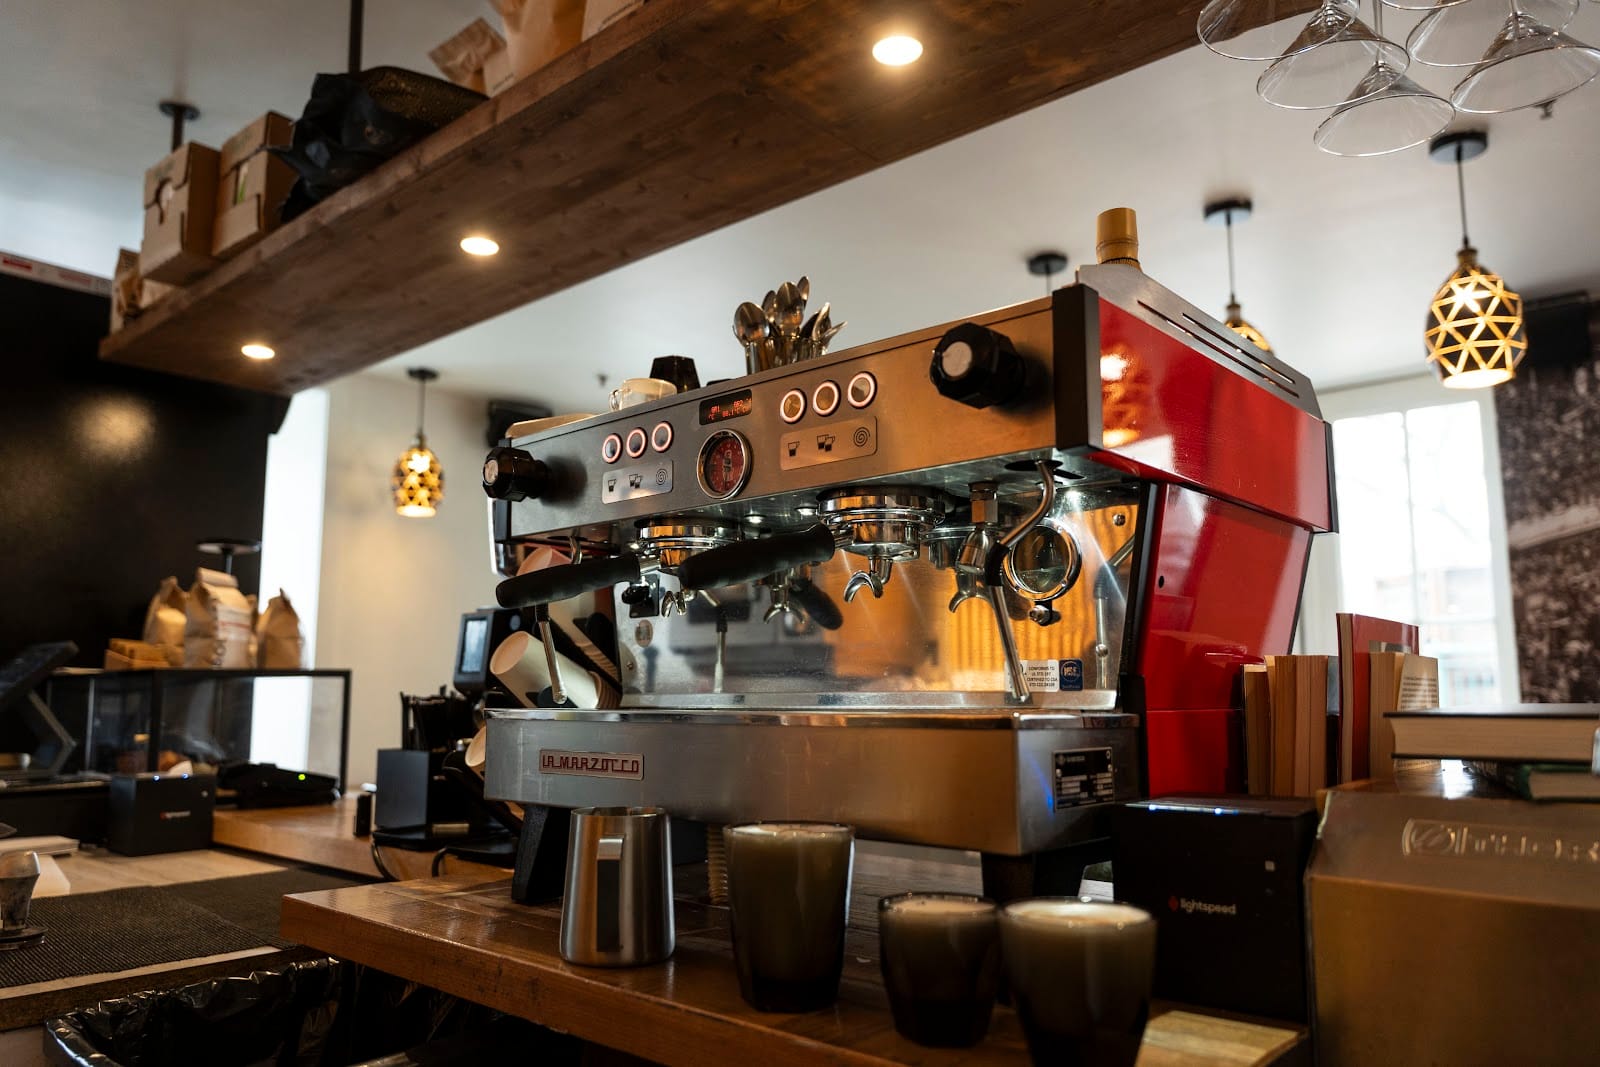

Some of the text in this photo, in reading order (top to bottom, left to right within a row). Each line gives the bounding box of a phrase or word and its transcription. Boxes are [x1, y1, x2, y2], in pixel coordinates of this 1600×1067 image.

[542, 755, 639, 773] LA MARZOCCO
[1180, 898, 1236, 914] lightspeed
